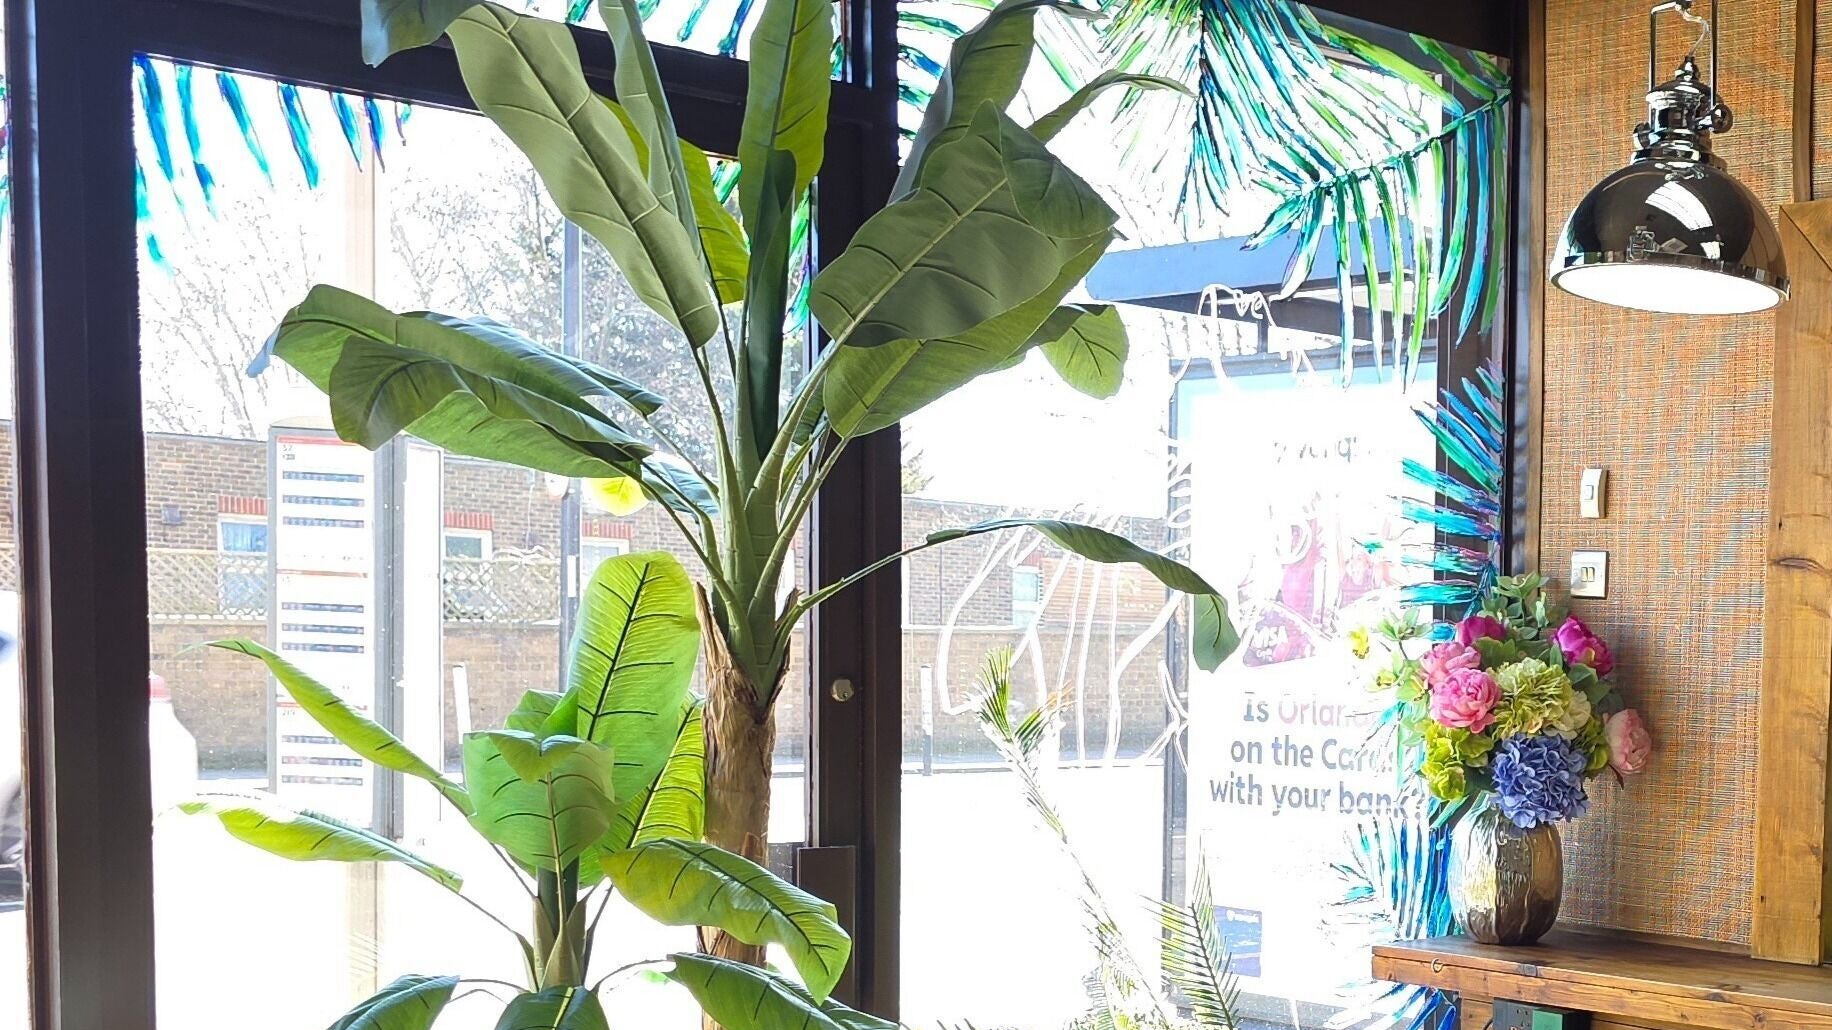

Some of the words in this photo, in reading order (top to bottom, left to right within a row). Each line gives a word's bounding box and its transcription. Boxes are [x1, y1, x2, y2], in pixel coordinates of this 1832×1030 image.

[1243, 690, 1270, 723] Is
[1230, 740, 1263, 764] on
[1272, 734, 1314, 768] the
[1209, 771, 1263, 806] with
[1272, 784, 1331, 817] your
